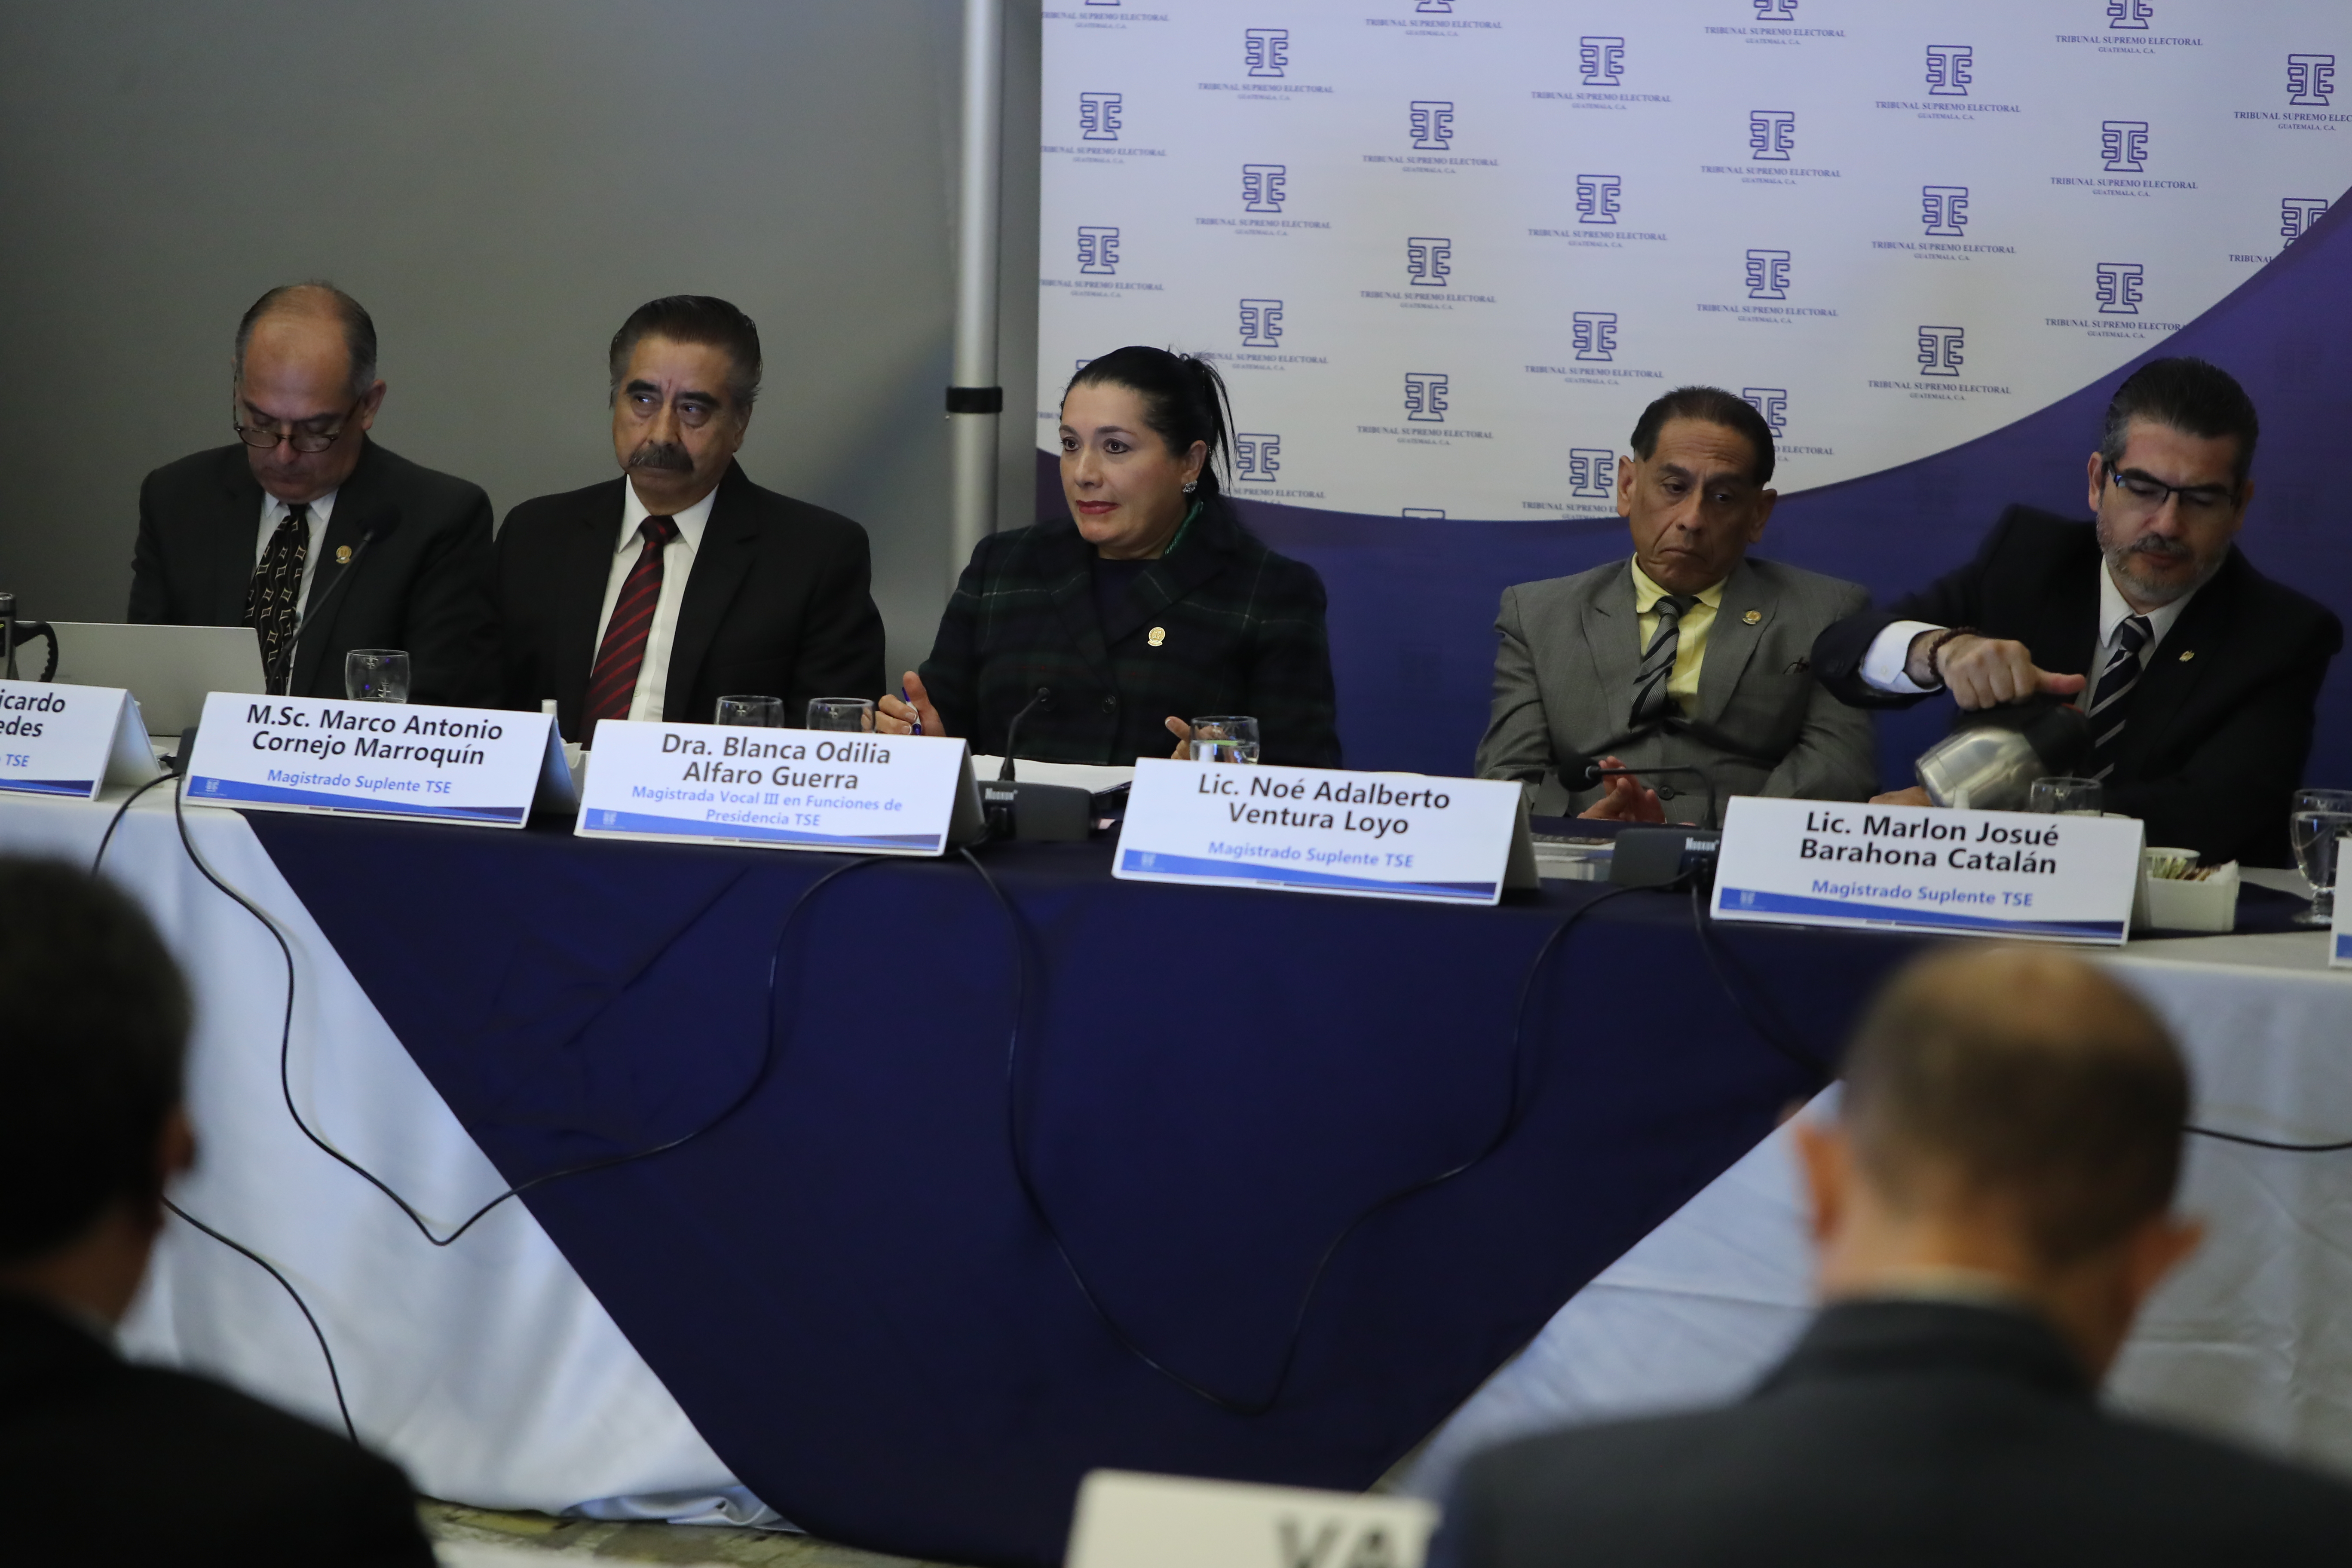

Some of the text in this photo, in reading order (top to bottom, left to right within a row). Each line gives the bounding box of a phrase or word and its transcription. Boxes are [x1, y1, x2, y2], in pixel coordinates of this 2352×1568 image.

[1793, 29, 1845, 37] ELECTORAL
[2055, 35, 2203, 46] TRIBUNAL SUPREMO ELECTORAL
[1531, 92, 1574, 100] TRIBUNAL
[1620, 94, 1671, 102] ELECTORAL
[1875, 101, 1920, 110] TRIBUNAL
[1967, 104, 2021, 112] ELECTORAL
[2234, 111, 2352, 122] TRIBUNAL SUPREMO ELEC
[1701, 165, 1841, 177] TRIBUNAL SUPREMO ELECTORAL
[2050, 177, 2198, 189] TRIBUNAL SUPREMO ELECTORAL
[1528, 229, 1570, 237] TRIBUNAL
[1616, 232, 1667, 241] ELECTORAL
[1871, 241, 2016, 254] TRIBUNAL SUPREMO ELECTORAL
[1697, 304, 1838, 316] TRIBUNAL SUPREMO ELECTORAL
[2045, 318, 2089, 328] TRIBUNAL
[2091, 320, 2136, 329] SUPREMO
[1525, 365, 1663, 378] TRIBUNAL SUPREMO ELECTORAL
[1868, 380, 2011, 394] TRIBUNAL SUPREMO ELECTORAL
[1782, 446, 1834, 455] ELECTORAL
[1522, 501, 1563, 510] TRIBUNAL
[1566, 504, 1608, 512] SUPREMO
[247, 704, 502, 740] M.Sc. Marco Antonio
[253, 731, 484, 768] Cornejo Marroquín
[662, 733, 890, 763] Dra. Blanca Odilia
[6, 753, 30, 767] TSE
[267, 769, 452, 793] Magistrado Suplente TSE
[682, 761, 858, 789] Alfaro Guerra
[1198, 773, 1450, 809] Lic. Noé Adalberto
[632, 786, 902, 811] Magistrada Vocal III en Funciones de
[706, 809, 821, 826] Presidencia TSE
[1230, 802, 1409, 839] Ventura Loyo
[1807, 811, 2059, 847] Lic. Marlon Josué
[1209, 842, 1413, 867] Magistrado Suplente TSE
[1800, 838, 2056, 875] Barahona Catalán
[1812, 879, 2033, 907] Magistrado Suplente TSE
